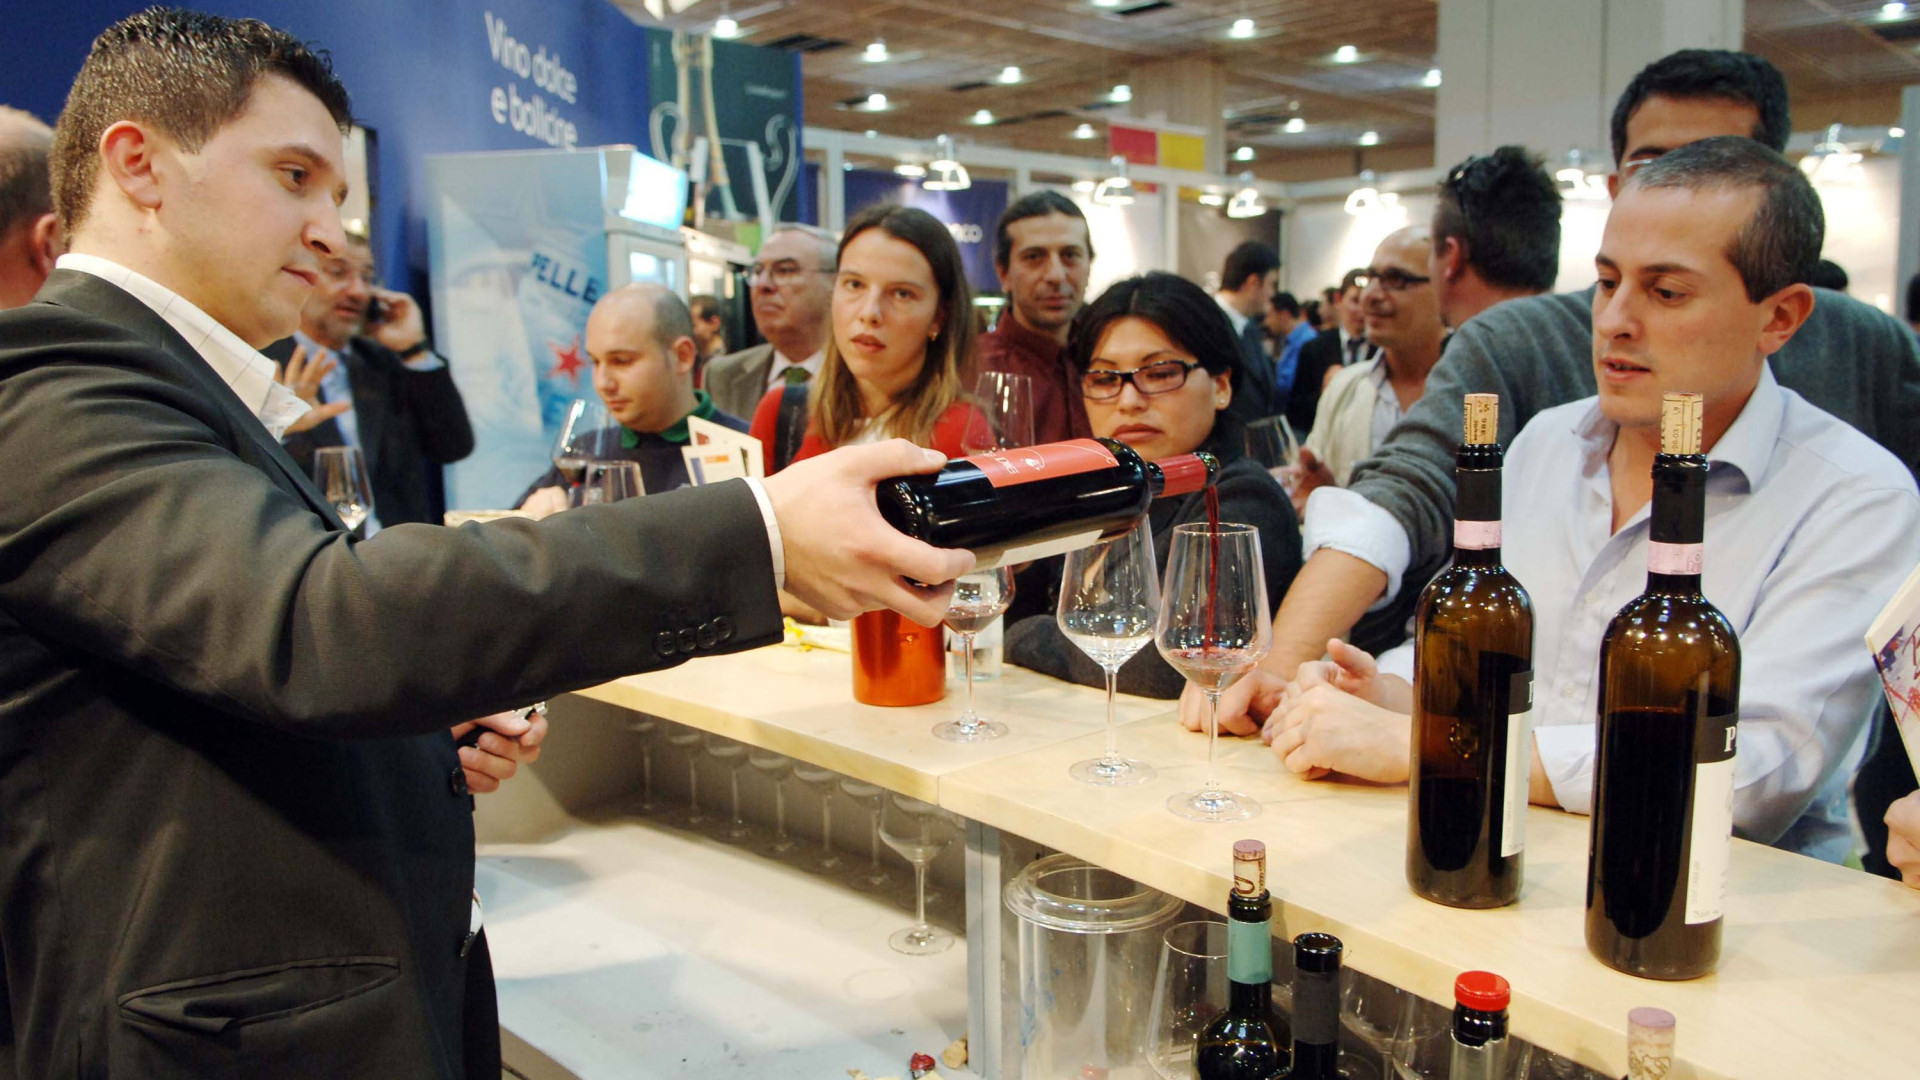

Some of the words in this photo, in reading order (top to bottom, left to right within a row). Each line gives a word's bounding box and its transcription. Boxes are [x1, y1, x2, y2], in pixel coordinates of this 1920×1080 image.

[484, 10, 531, 79] Vino
[531, 43, 578, 105] dolce
[490, 86, 508, 125] e
